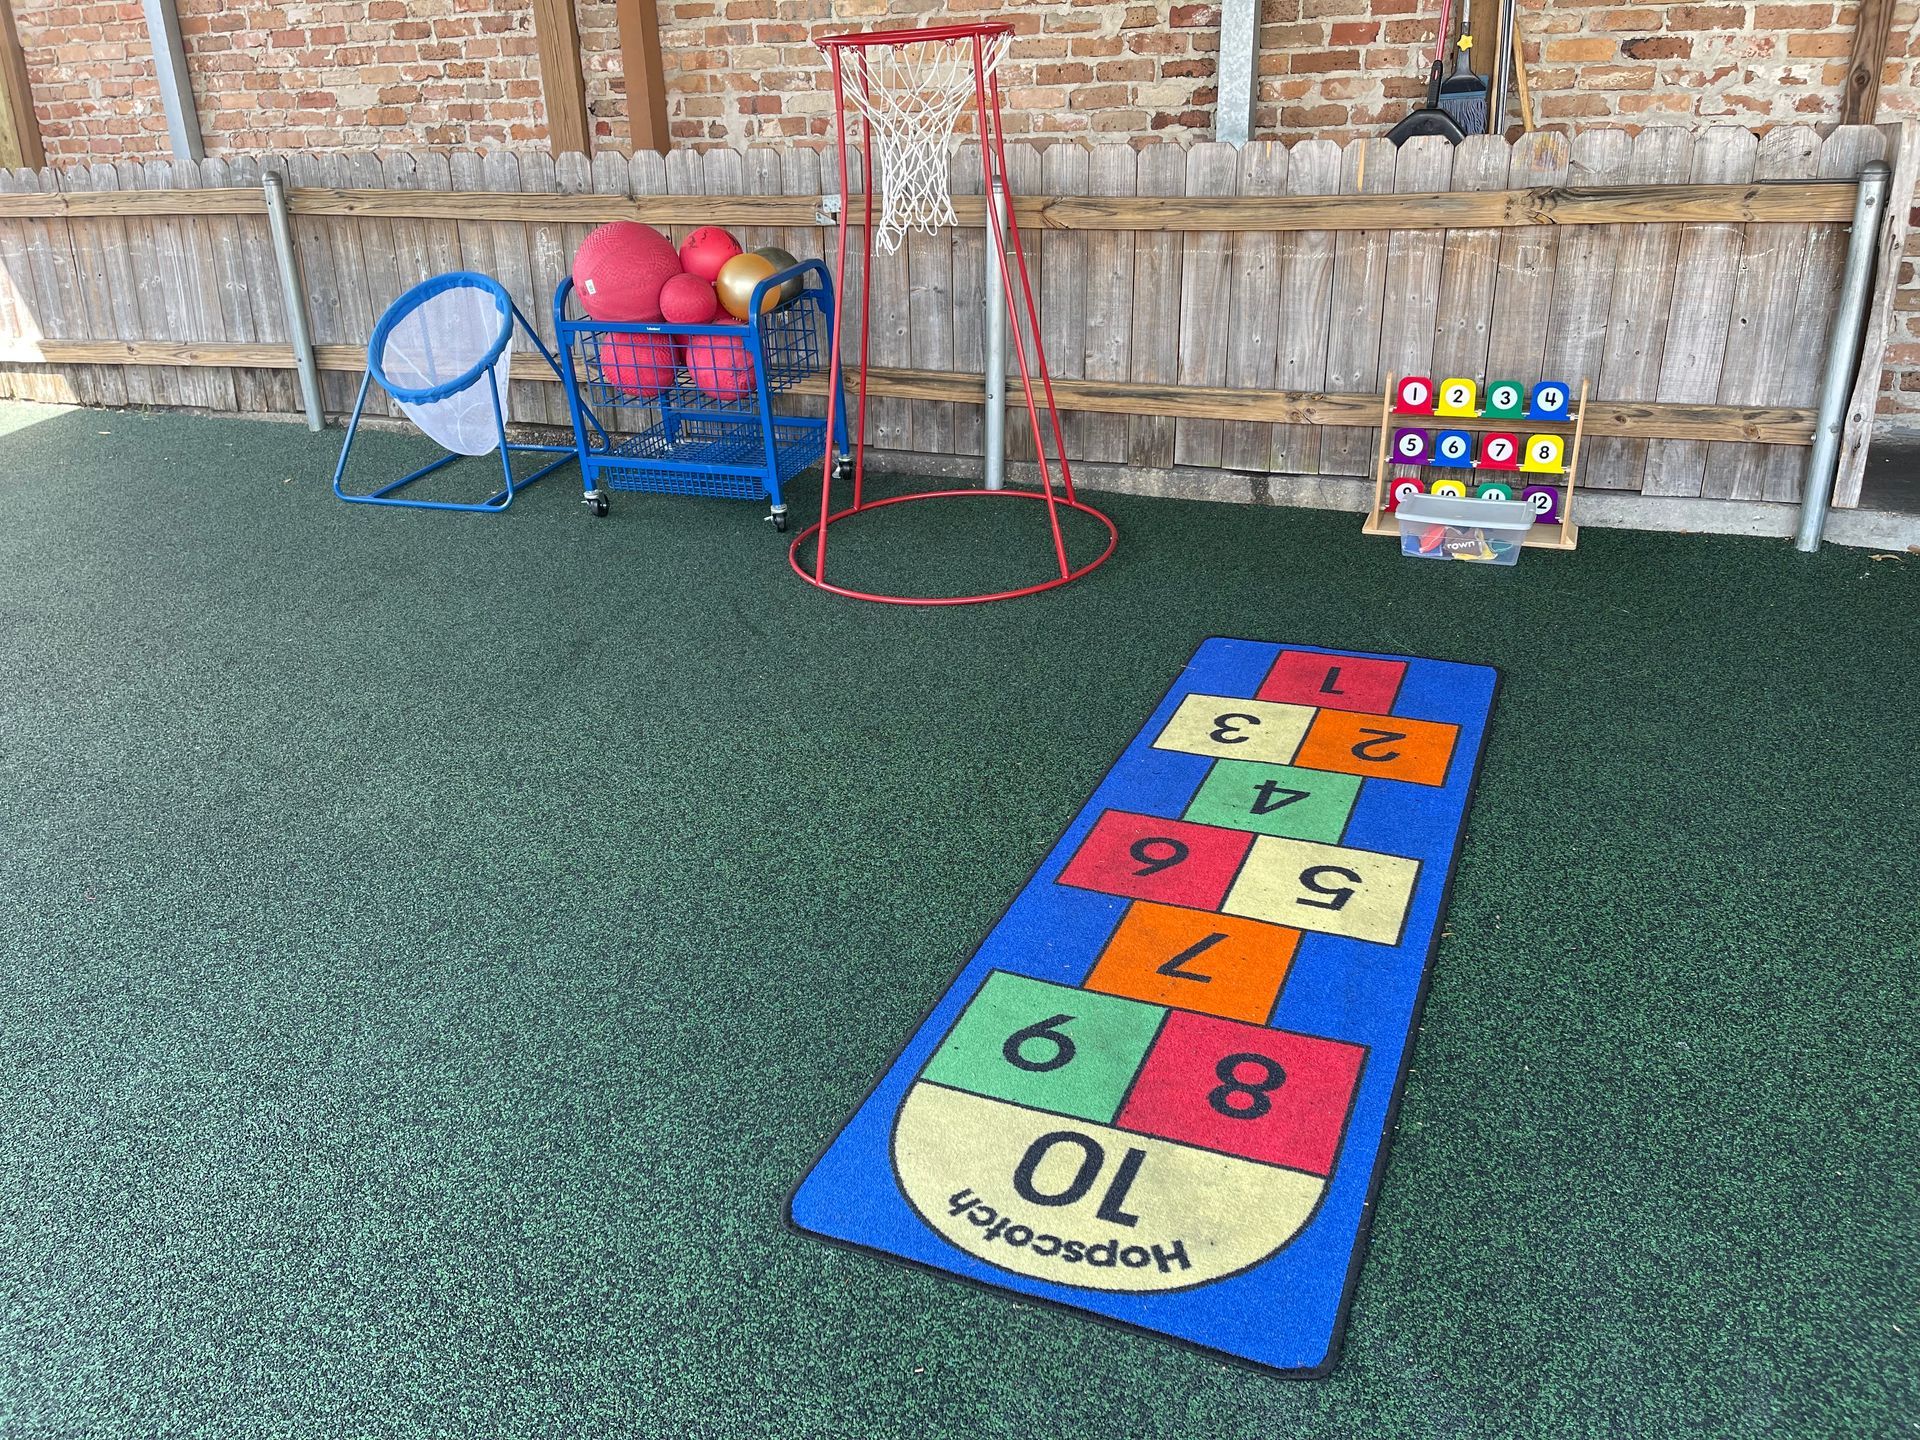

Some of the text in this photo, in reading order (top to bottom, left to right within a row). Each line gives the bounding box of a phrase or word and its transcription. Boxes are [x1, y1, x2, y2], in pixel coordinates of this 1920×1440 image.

[1413, 387, 1557, 407] 1 2 3 4
[1406, 438, 1550, 459] 5 6 7 8
[1446, 540, 1476, 550] rown
[1319, 666, 1344, 695] 1
[1209, 713, 1261, 744] 3
[1351, 728, 1406, 762] 2
[1250, 779, 1311, 815] 4
[1129, 837, 1189, 876] 6
[1296, 865, 1363, 911] 5
[1156, 932, 1230, 983] 7
[1002, 1013, 1077, 1073] 9
[1207, 1053, 1287, 1120] 8
[1012, 1130, 1148, 1228] 10
[948, 1188, 1193, 1275] Hopscotch
